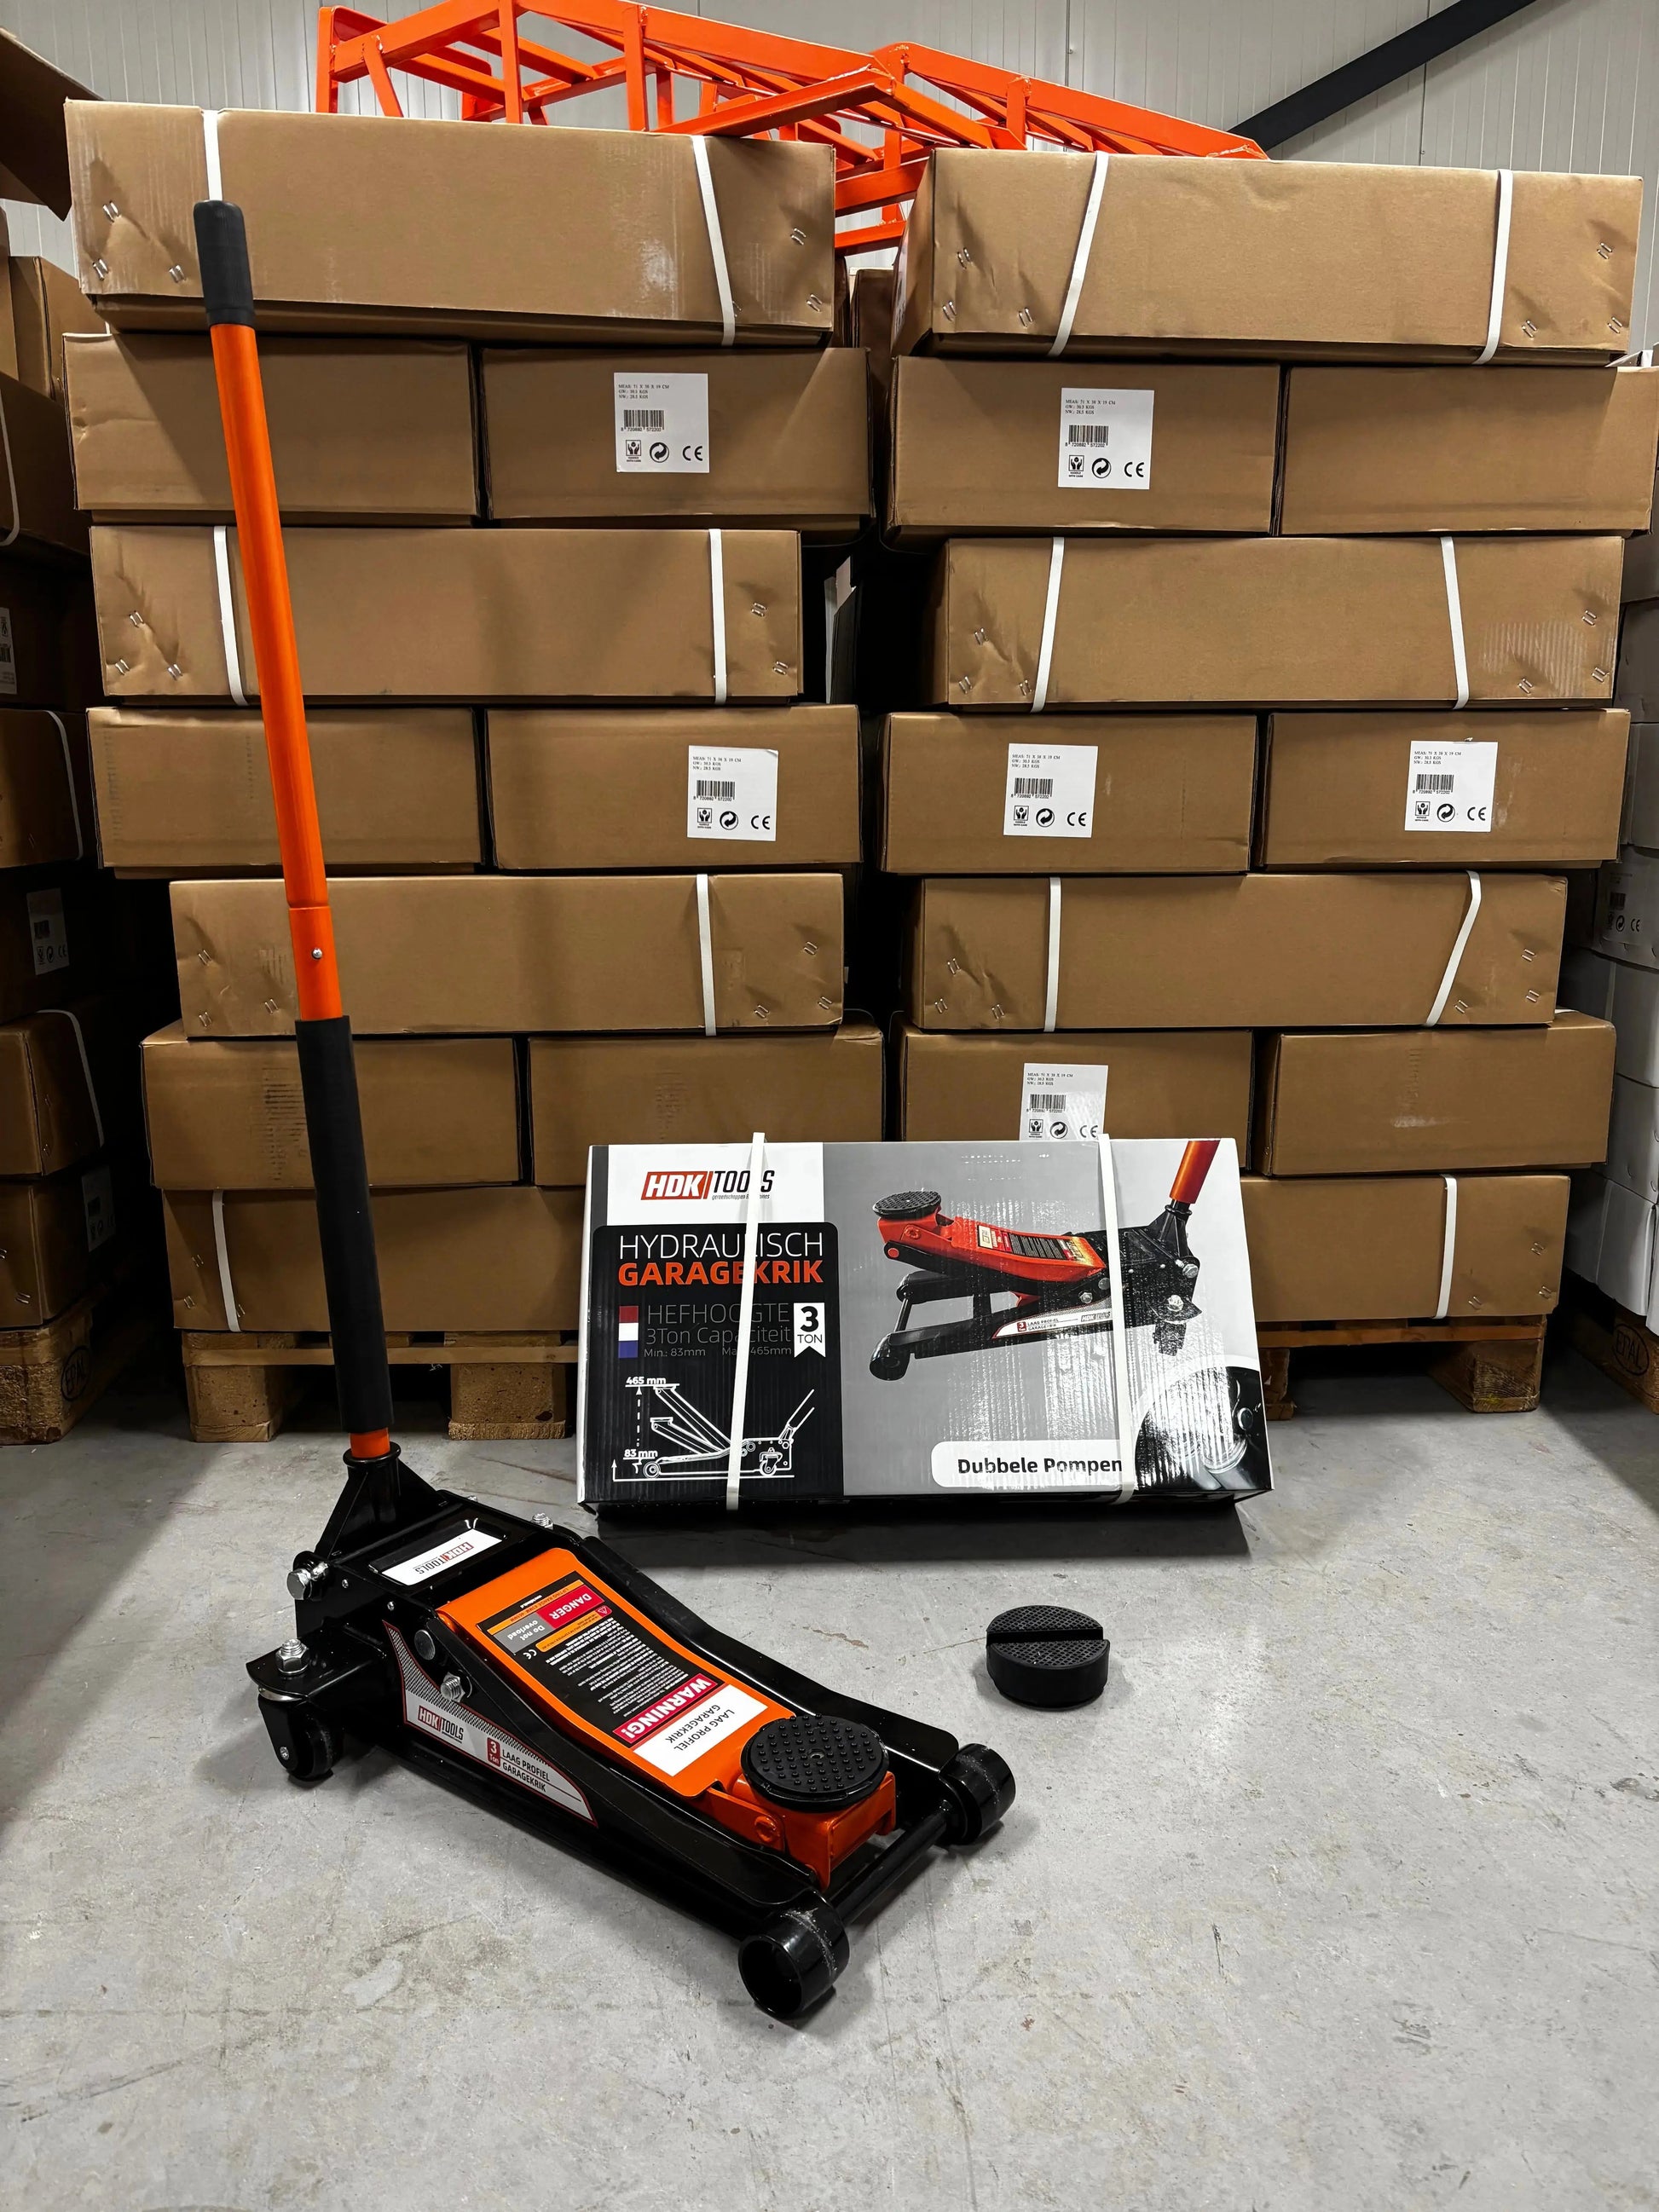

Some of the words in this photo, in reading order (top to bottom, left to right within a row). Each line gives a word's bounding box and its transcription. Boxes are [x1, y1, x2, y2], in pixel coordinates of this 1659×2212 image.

[683, 446, 703, 461] CE
[1124, 462, 1145, 478] CE
[1067, 812, 1087, 827] CE
[1467, 807, 1487, 821] CE
[751, 816, 771, 830] CE
[645, 1174, 705, 1198] HDK
[714, 1170, 775, 1193] TOOS
[620, 1232, 824, 1259] HYDRAUISCH
[618, 1260, 824, 1286] GARAGEKRIK
[800, 1306, 818, 1332] 3
[646, 1328, 691, 1344] 3Ton
[797, 1334, 823, 1344] TON
[670, 1348, 706, 1357] 83mm
[750, 1346, 792, 1355] 465mm
[626, 1377, 645, 1385] 465
[624, 1449, 637, 1458] 83
[638, 1450, 658, 1458] mm
[957, 1458, 1038, 1474] Dubbele
[1043, 1458, 1123, 1476] Pompen
[548, 1593, 592, 1620] DANGER
[506, 1620, 540, 1640] overload
[518, 1631, 534, 1641] not
[532, 1625, 546, 1633] Do
[522, 1649, 539, 1660] CE
[620, 1678, 712, 1739] WARNING!
[419, 1707, 439, 1730] HDK
[442, 1718, 464, 1741] TOOLS
[664, 1704, 722, 1744] GARAGEKRIK
[708, 1709, 736, 1728] LAAG
[490, 1741, 497, 1753] 3
[673, 1725, 712, 1753] PROFIEL
[489, 1753, 500, 1764] Ton
[502, 1749, 521, 1765] LAAG
[522, 1760, 550, 1782] PROFIEL
[502, 1762, 546, 1793] GARAGEKRIK
